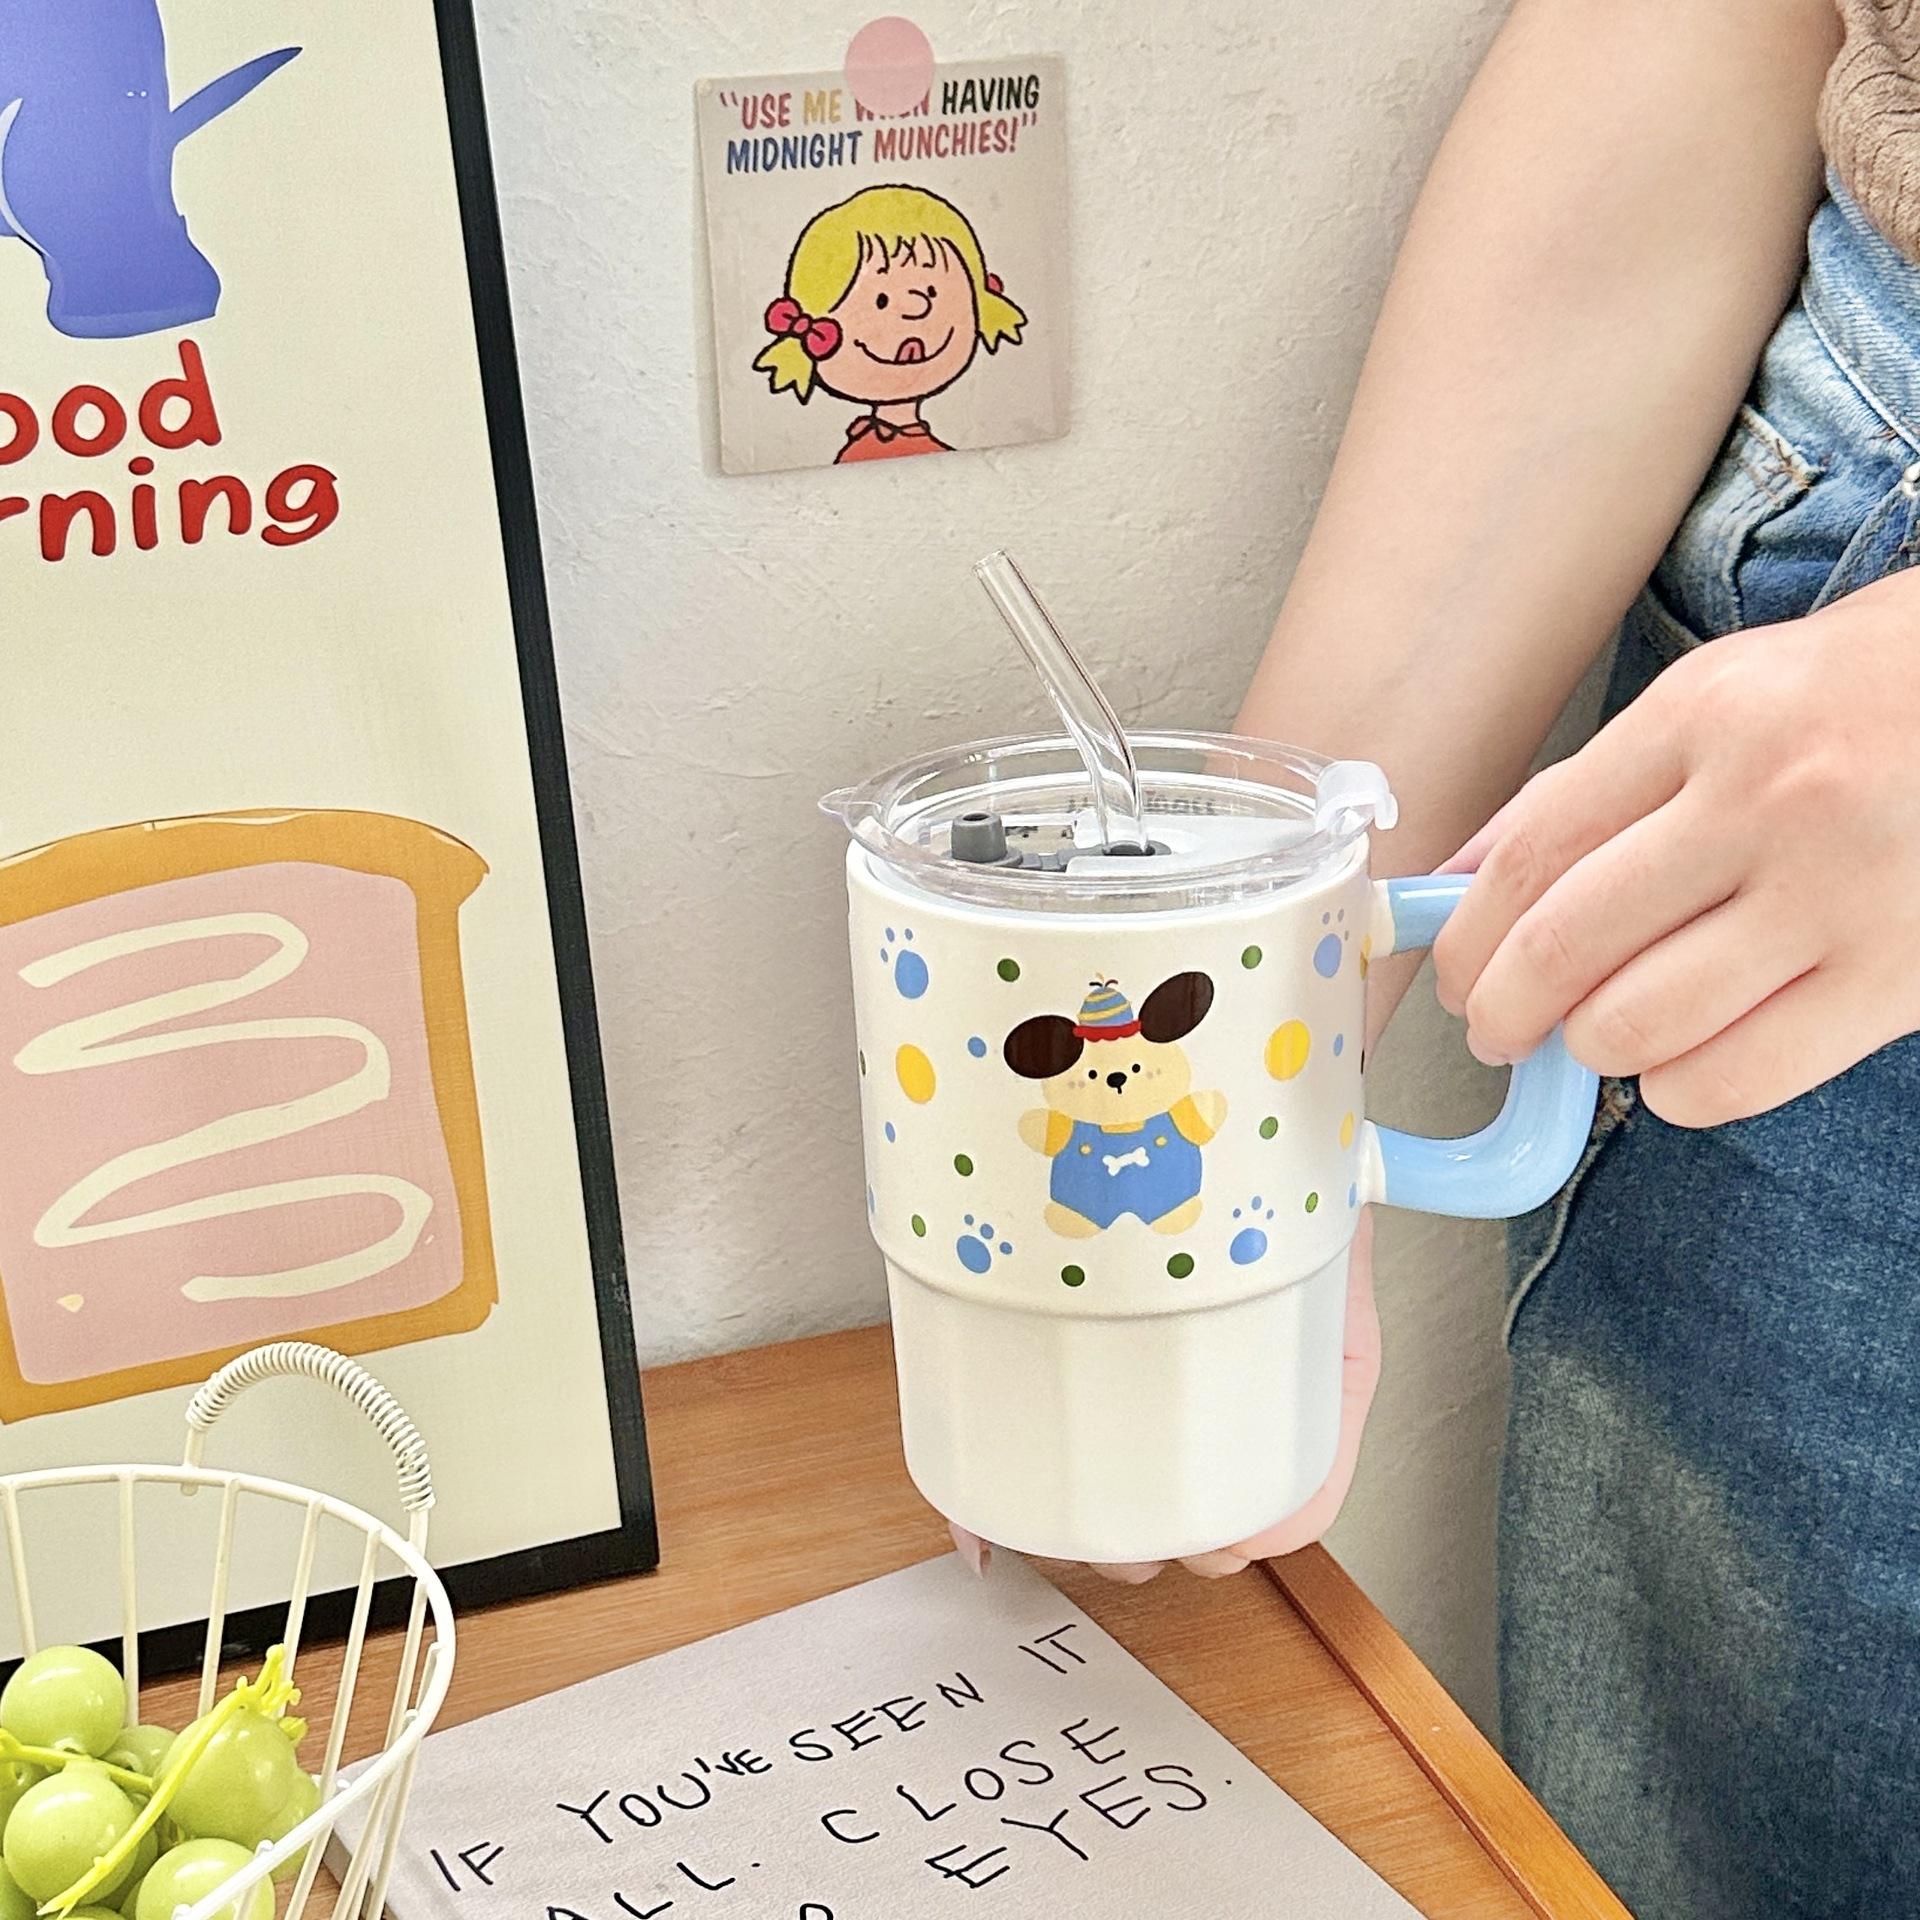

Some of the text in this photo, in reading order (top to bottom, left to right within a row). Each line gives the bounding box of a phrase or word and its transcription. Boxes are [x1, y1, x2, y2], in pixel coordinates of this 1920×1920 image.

[726, 129, 863, 175] MIDNIGHT
[803, 88, 843, 125] ME
[941, 74, 1041, 116] HAVING
[430, 1623, 1087, 1892] IF YOU'VE SEEN IT
[820, 1717, 1126, 1844] CLOSE
[924, 1764, 1233, 1889] EYES.
